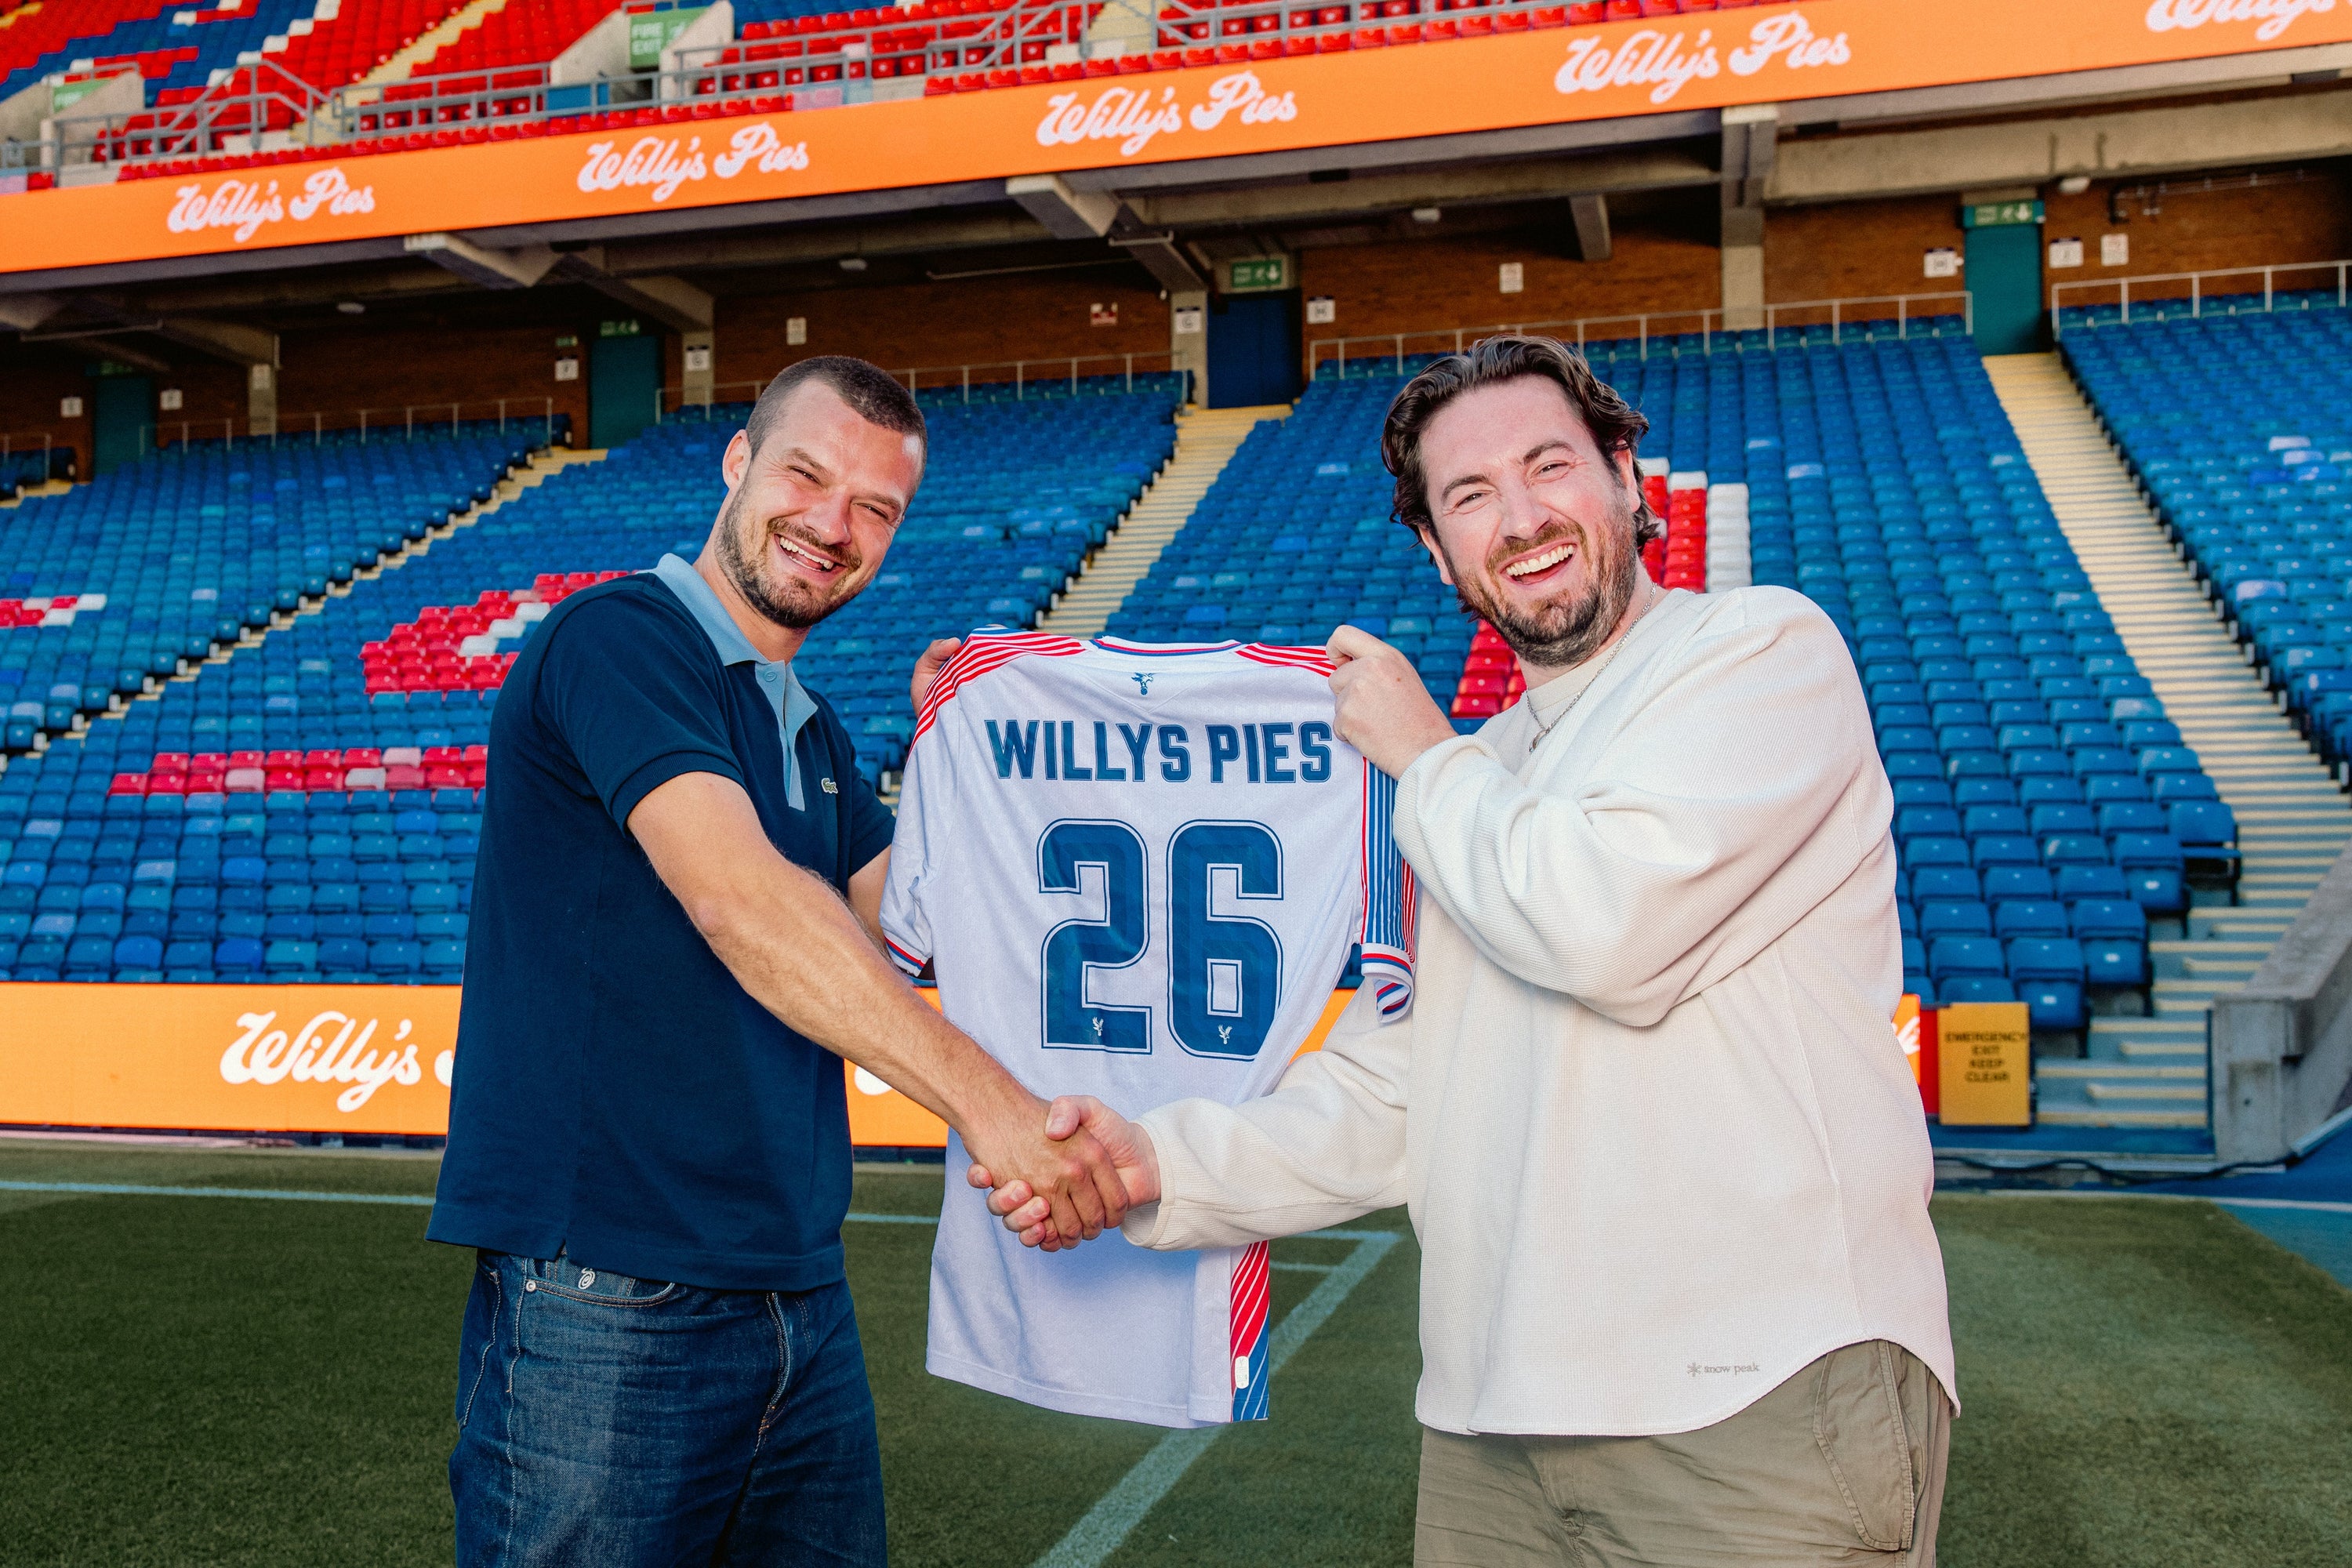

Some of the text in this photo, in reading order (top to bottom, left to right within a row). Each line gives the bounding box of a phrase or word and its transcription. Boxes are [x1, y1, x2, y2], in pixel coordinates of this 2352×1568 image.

[1555, 11, 1851, 103] Willy's Pies
[1036, 71, 1298, 156] Willy's Pies
[578, 122, 809, 202] Willy's Pies
[167, 167, 375, 242] Willy's Pies
[984, 719, 1333, 784] WILLYS PIES
[1036, 817, 1284, 1062] 26
[220, 1010, 422, 1112] Willy's
[1945, 1031, 2026, 1043] EMERGENCY
[1969, 1058, 2004, 1069] KEEP
[1972, 1044, 2001, 1055] EXIT
[1964, 1071, 2009, 1082] CLEAR
[1734, 1362, 1761, 1376] peak
